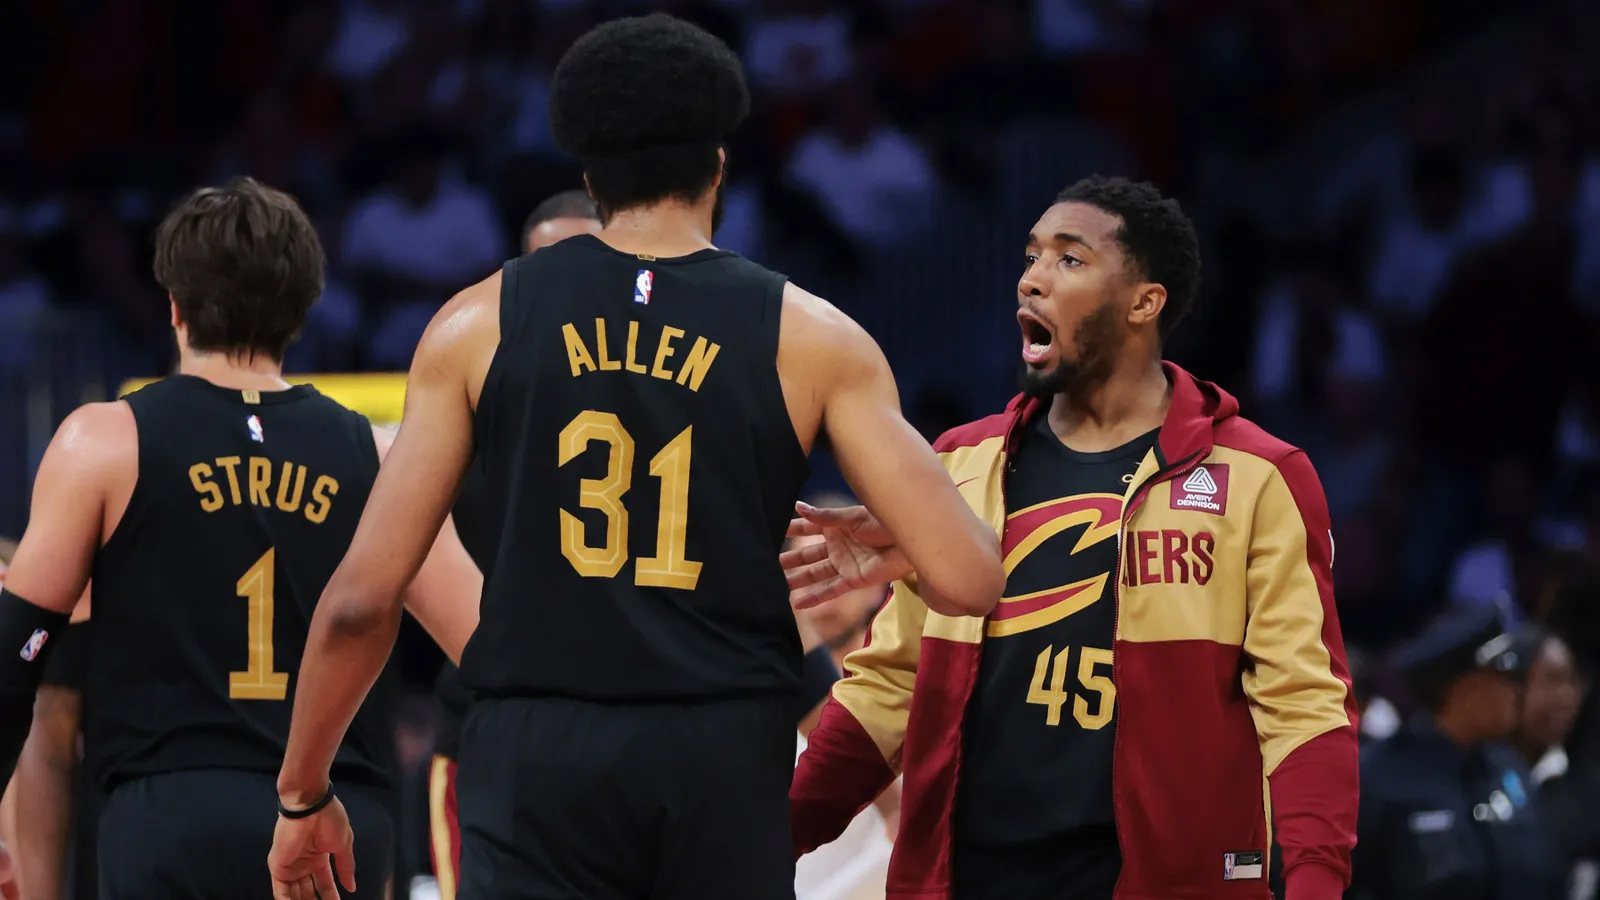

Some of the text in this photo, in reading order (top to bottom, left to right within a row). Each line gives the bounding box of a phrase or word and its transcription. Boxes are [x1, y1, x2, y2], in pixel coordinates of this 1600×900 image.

[561, 317, 721, 392] ALLEN
[188, 455, 340, 524] STRUS
[558, 409, 703, 591] 31
[1177, 499, 1220, 511] DENNISON
[1185, 494, 1213, 502] AVERY
[1121, 529, 1215, 587] IERS
[229, 547, 289, 700] 1
[1026, 644, 1116, 730] 45
